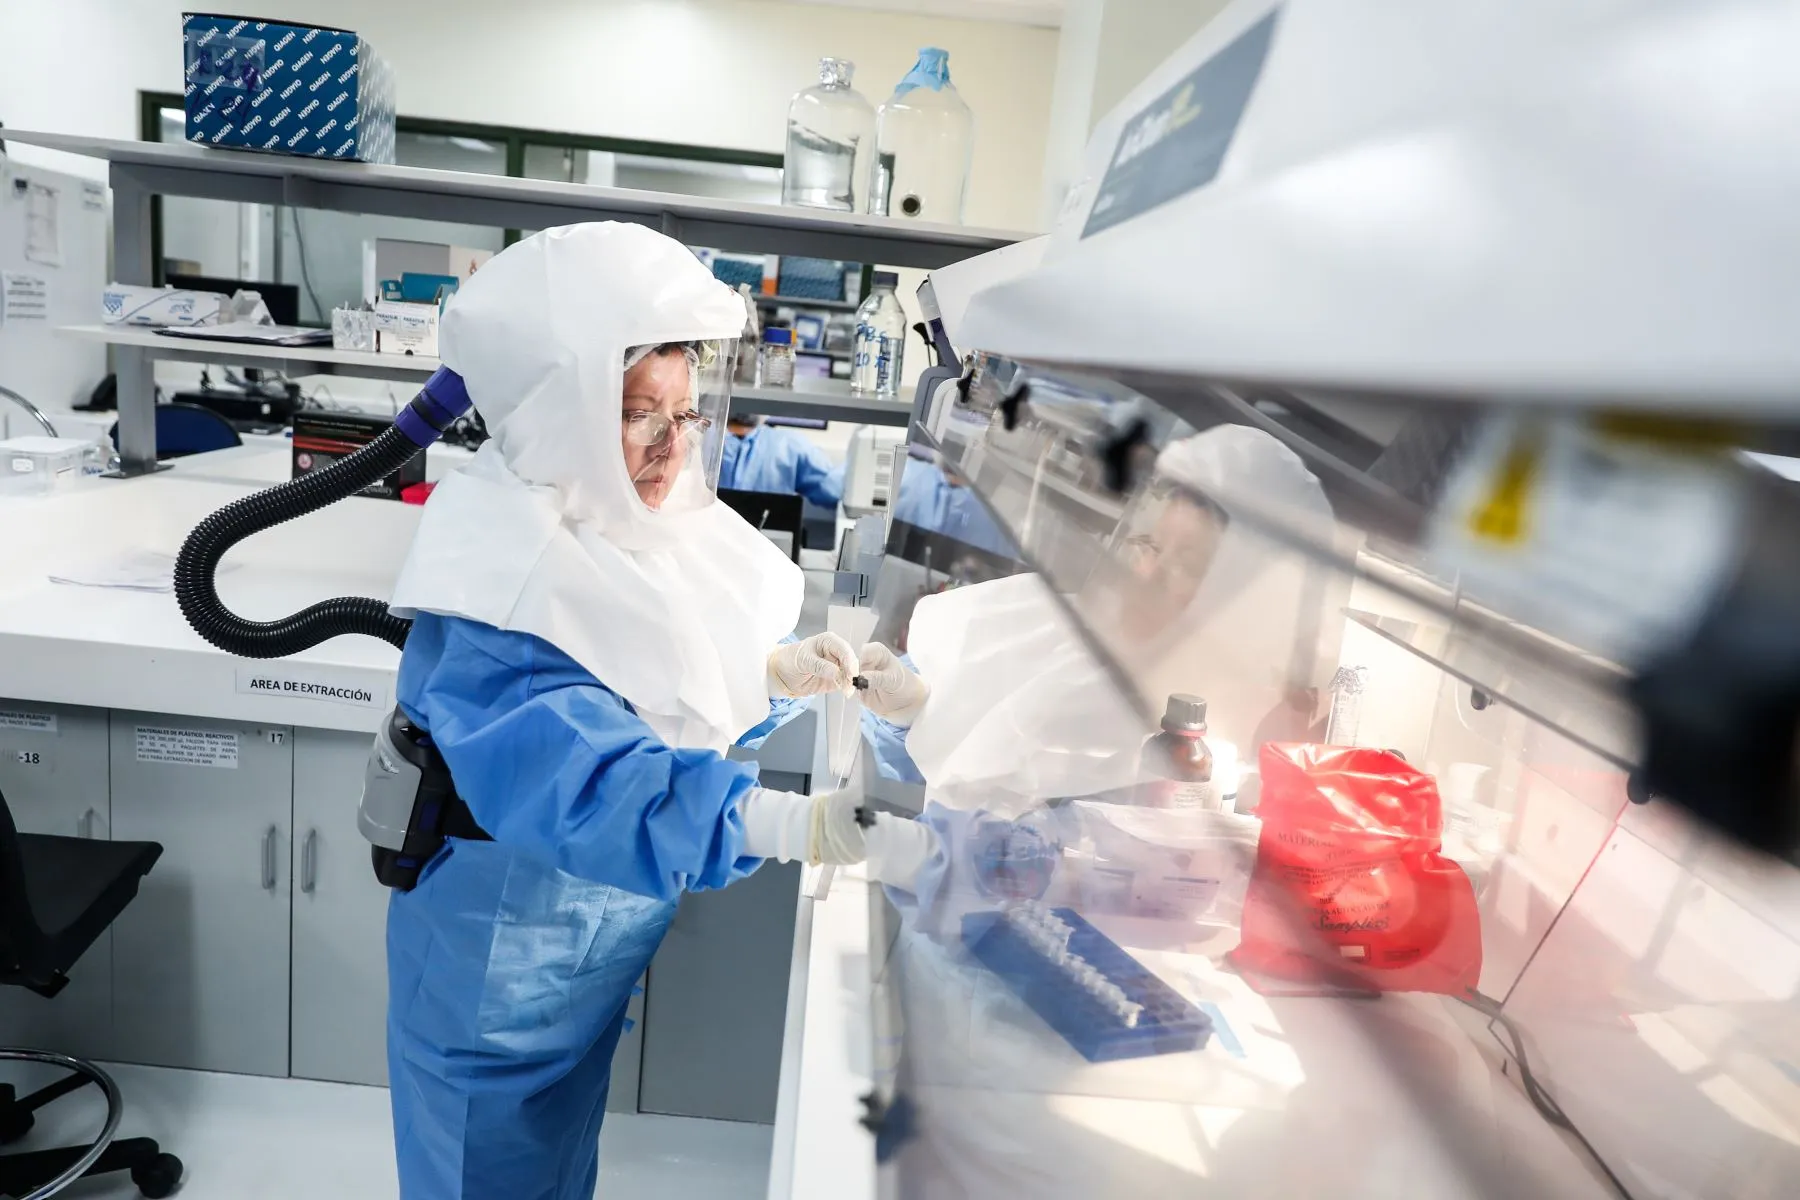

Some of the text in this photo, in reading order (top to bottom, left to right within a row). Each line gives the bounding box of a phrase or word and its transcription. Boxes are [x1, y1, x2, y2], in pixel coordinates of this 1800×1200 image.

[197, 26, 219, 47] QIAGEN
[273, 30, 296, 52] QIAGEN
[244, 39, 266, 60] QIAGEN
[320, 43, 342, 64] QIAGEN
[262, 59, 284, 80] QIAGEN
[291, 51, 314, 72] QIAGEN
[309, 71, 331, 92] QIAGEN
[338, 63, 360, 84] QIAGEN
[203, 75, 225, 96] QIAGEN
[280, 79, 302, 100] QIAGEN
[252, 87, 273, 107] QIAGEN
[327, 91, 349, 111] QIAGEN
[270, 107, 292, 127] QIAGEN
[298, 99, 320, 120] QIAGEN
[212, 122, 234, 143] QIAGEN
[240, 115, 262, 136] QIAGEN
[315, 119, 337, 139] QIAGEN
[288, 126, 309, 147] QIAGEN
[250, 679, 371, 702] AREA DE EXTRACCIÓN
[271, 733, 284, 743] 17
[19, 752, 40, 764] -18
